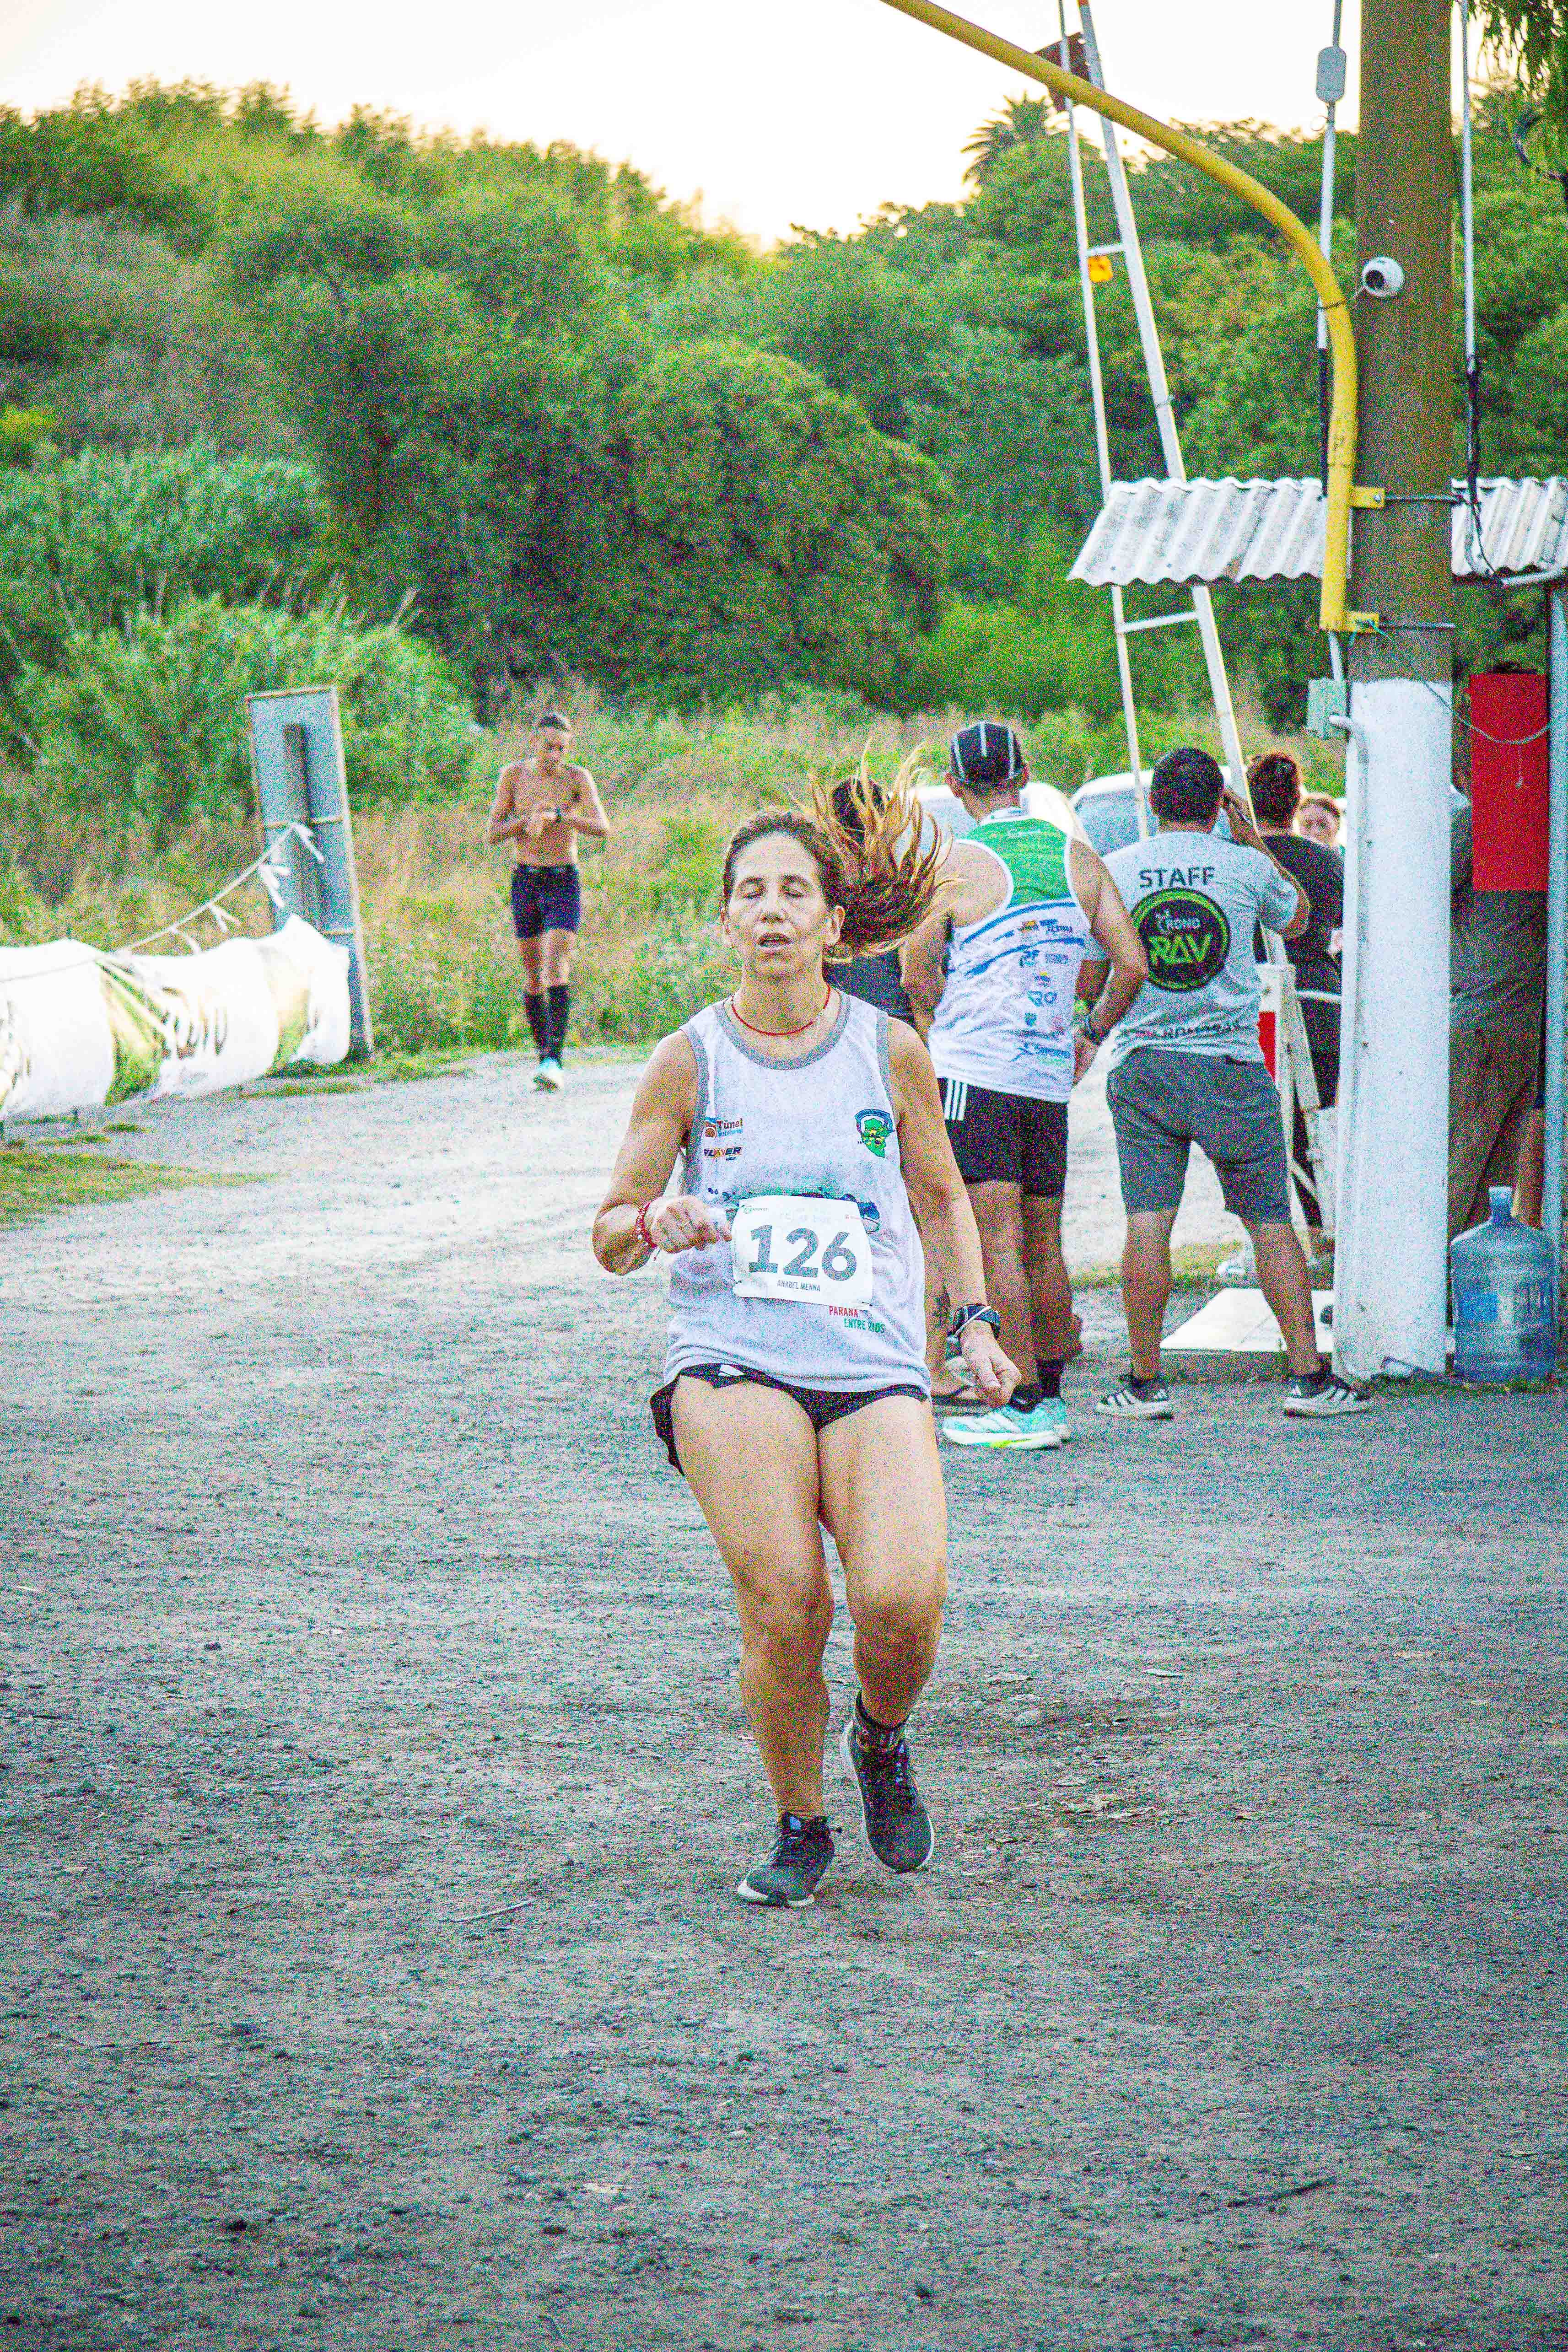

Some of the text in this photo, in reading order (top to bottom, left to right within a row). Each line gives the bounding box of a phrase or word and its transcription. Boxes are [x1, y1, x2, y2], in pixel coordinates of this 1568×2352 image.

[1139, 866, 1215, 888] STAFF
[1148, 933, 1212, 966] RAV
[749, 1225, 857, 1281] 126
[777, 1279, 820, 1292] ANABEL MENNA
[844, 1318, 866, 1330] ENTRE
